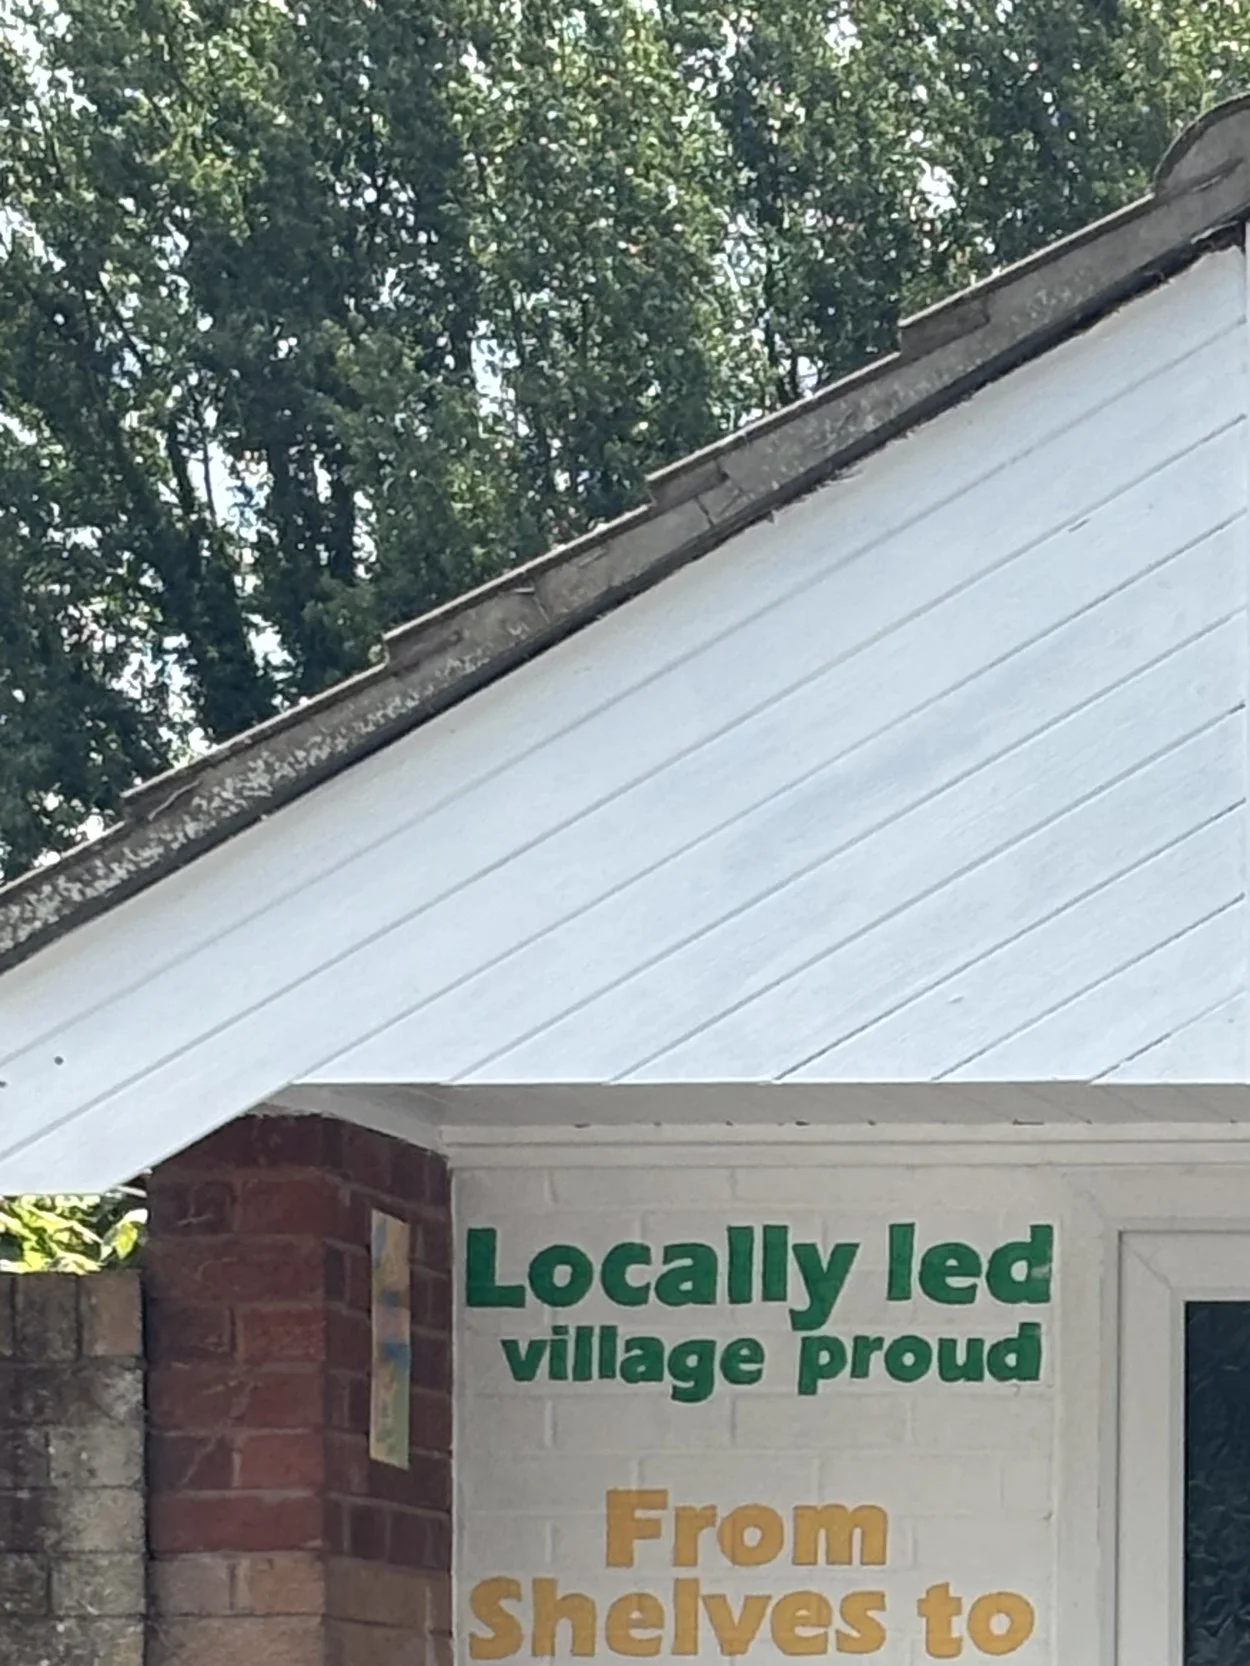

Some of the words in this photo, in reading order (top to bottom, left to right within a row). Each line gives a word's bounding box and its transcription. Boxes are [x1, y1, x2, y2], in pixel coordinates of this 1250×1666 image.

[465, 1224, 860, 1331] Locally
[887, 1223, 1054, 1305] led
[500, 1324, 765, 1403] village
[798, 1322, 1042, 1395] proud
[605, 1488, 888, 1568] From
[468, 1576, 887, 1660] Shelves
[917, 1581, 1034, 1659] to
